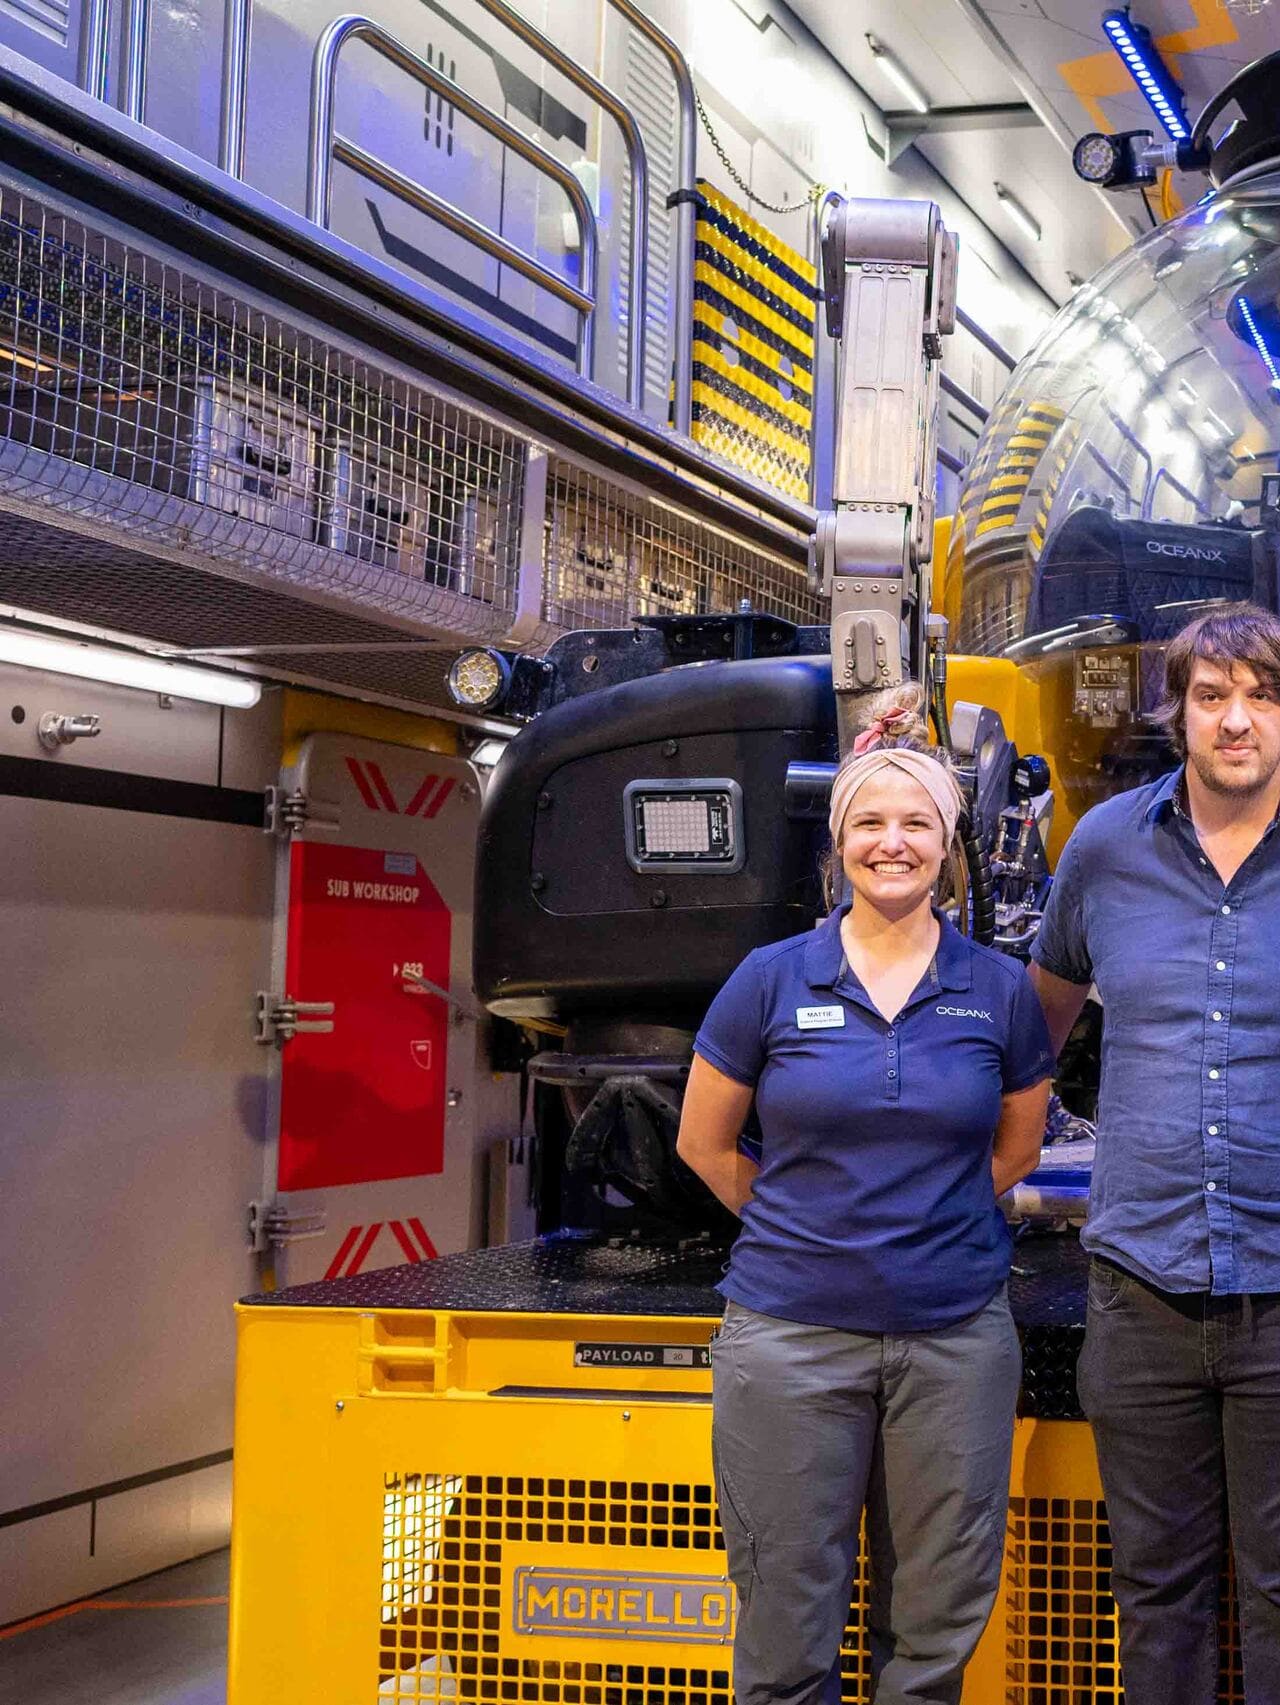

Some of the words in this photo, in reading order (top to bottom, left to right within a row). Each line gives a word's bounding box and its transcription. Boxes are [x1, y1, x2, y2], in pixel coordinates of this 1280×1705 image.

[1146, 540, 1227, 564] OCEANX
[326, 879, 350, 897] SUB
[352, 881, 420, 904] WORKSHOP
[936, 1005, 994, 1023] OCEANX
[583, 1349, 654, 1363] PAYLOAD
[671, 1351, 684, 1361] 20
[526, 1584, 727, 1628] MORELLO
